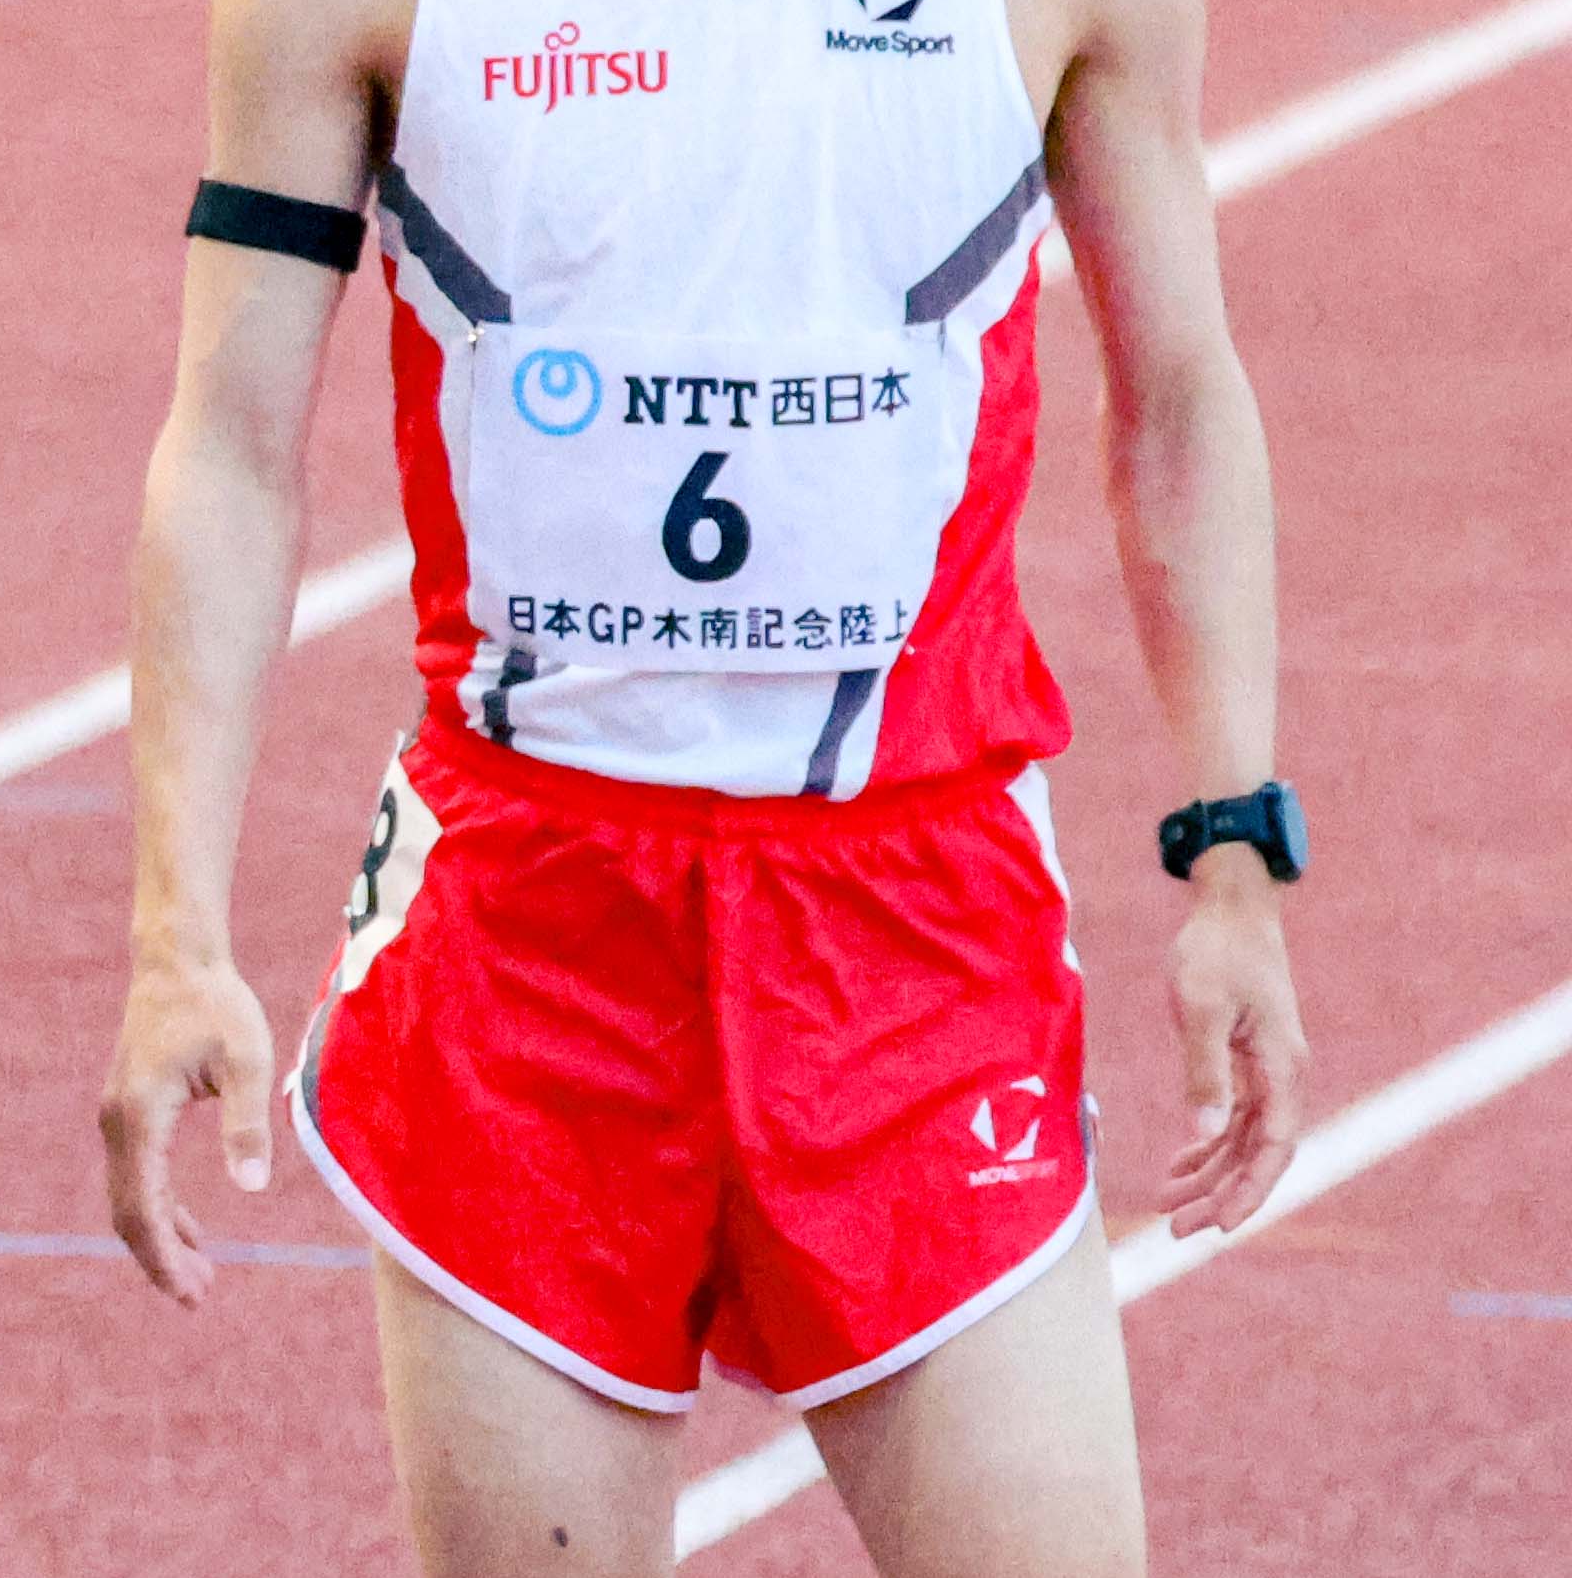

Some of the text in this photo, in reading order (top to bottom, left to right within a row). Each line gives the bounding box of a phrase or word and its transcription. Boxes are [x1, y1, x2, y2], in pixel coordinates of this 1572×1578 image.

[662, 451, 751, 582] 6
[508, 595, 909, 651] 日本GP木南記念陸上
